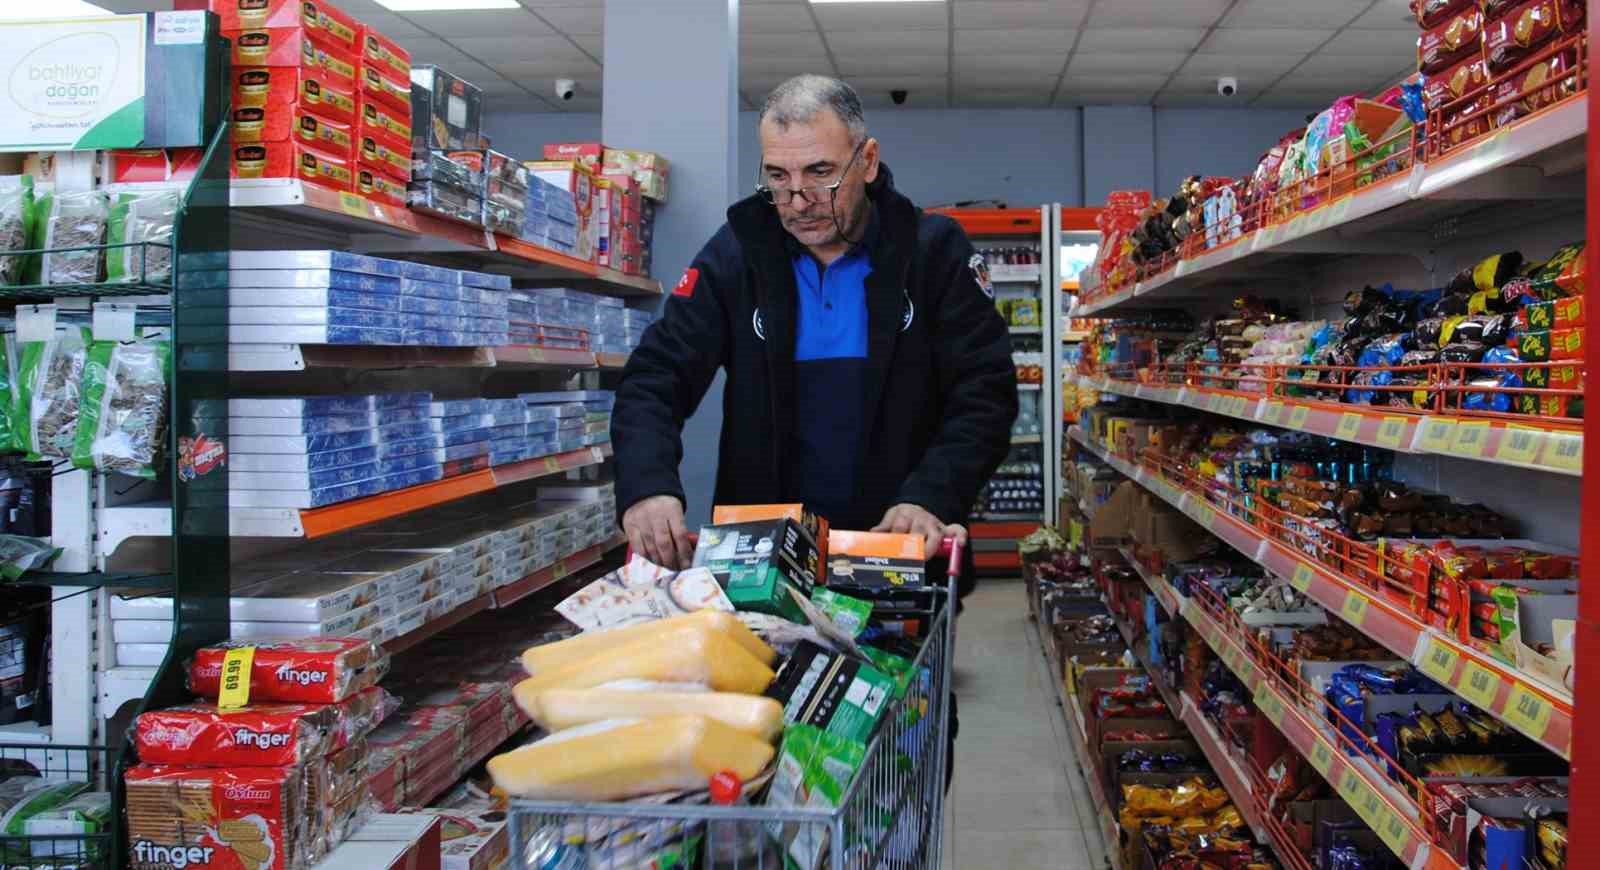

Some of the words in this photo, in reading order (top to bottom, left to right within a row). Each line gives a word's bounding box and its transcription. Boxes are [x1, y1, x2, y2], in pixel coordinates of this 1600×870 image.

[28, 64, 102, 82] bahtiyar
[225, 659, 241, 690] 69.99
[275, 663, 328, 685] finger
[234, 728, 291, 749] finger
[134, 841, 214, 868] finger
